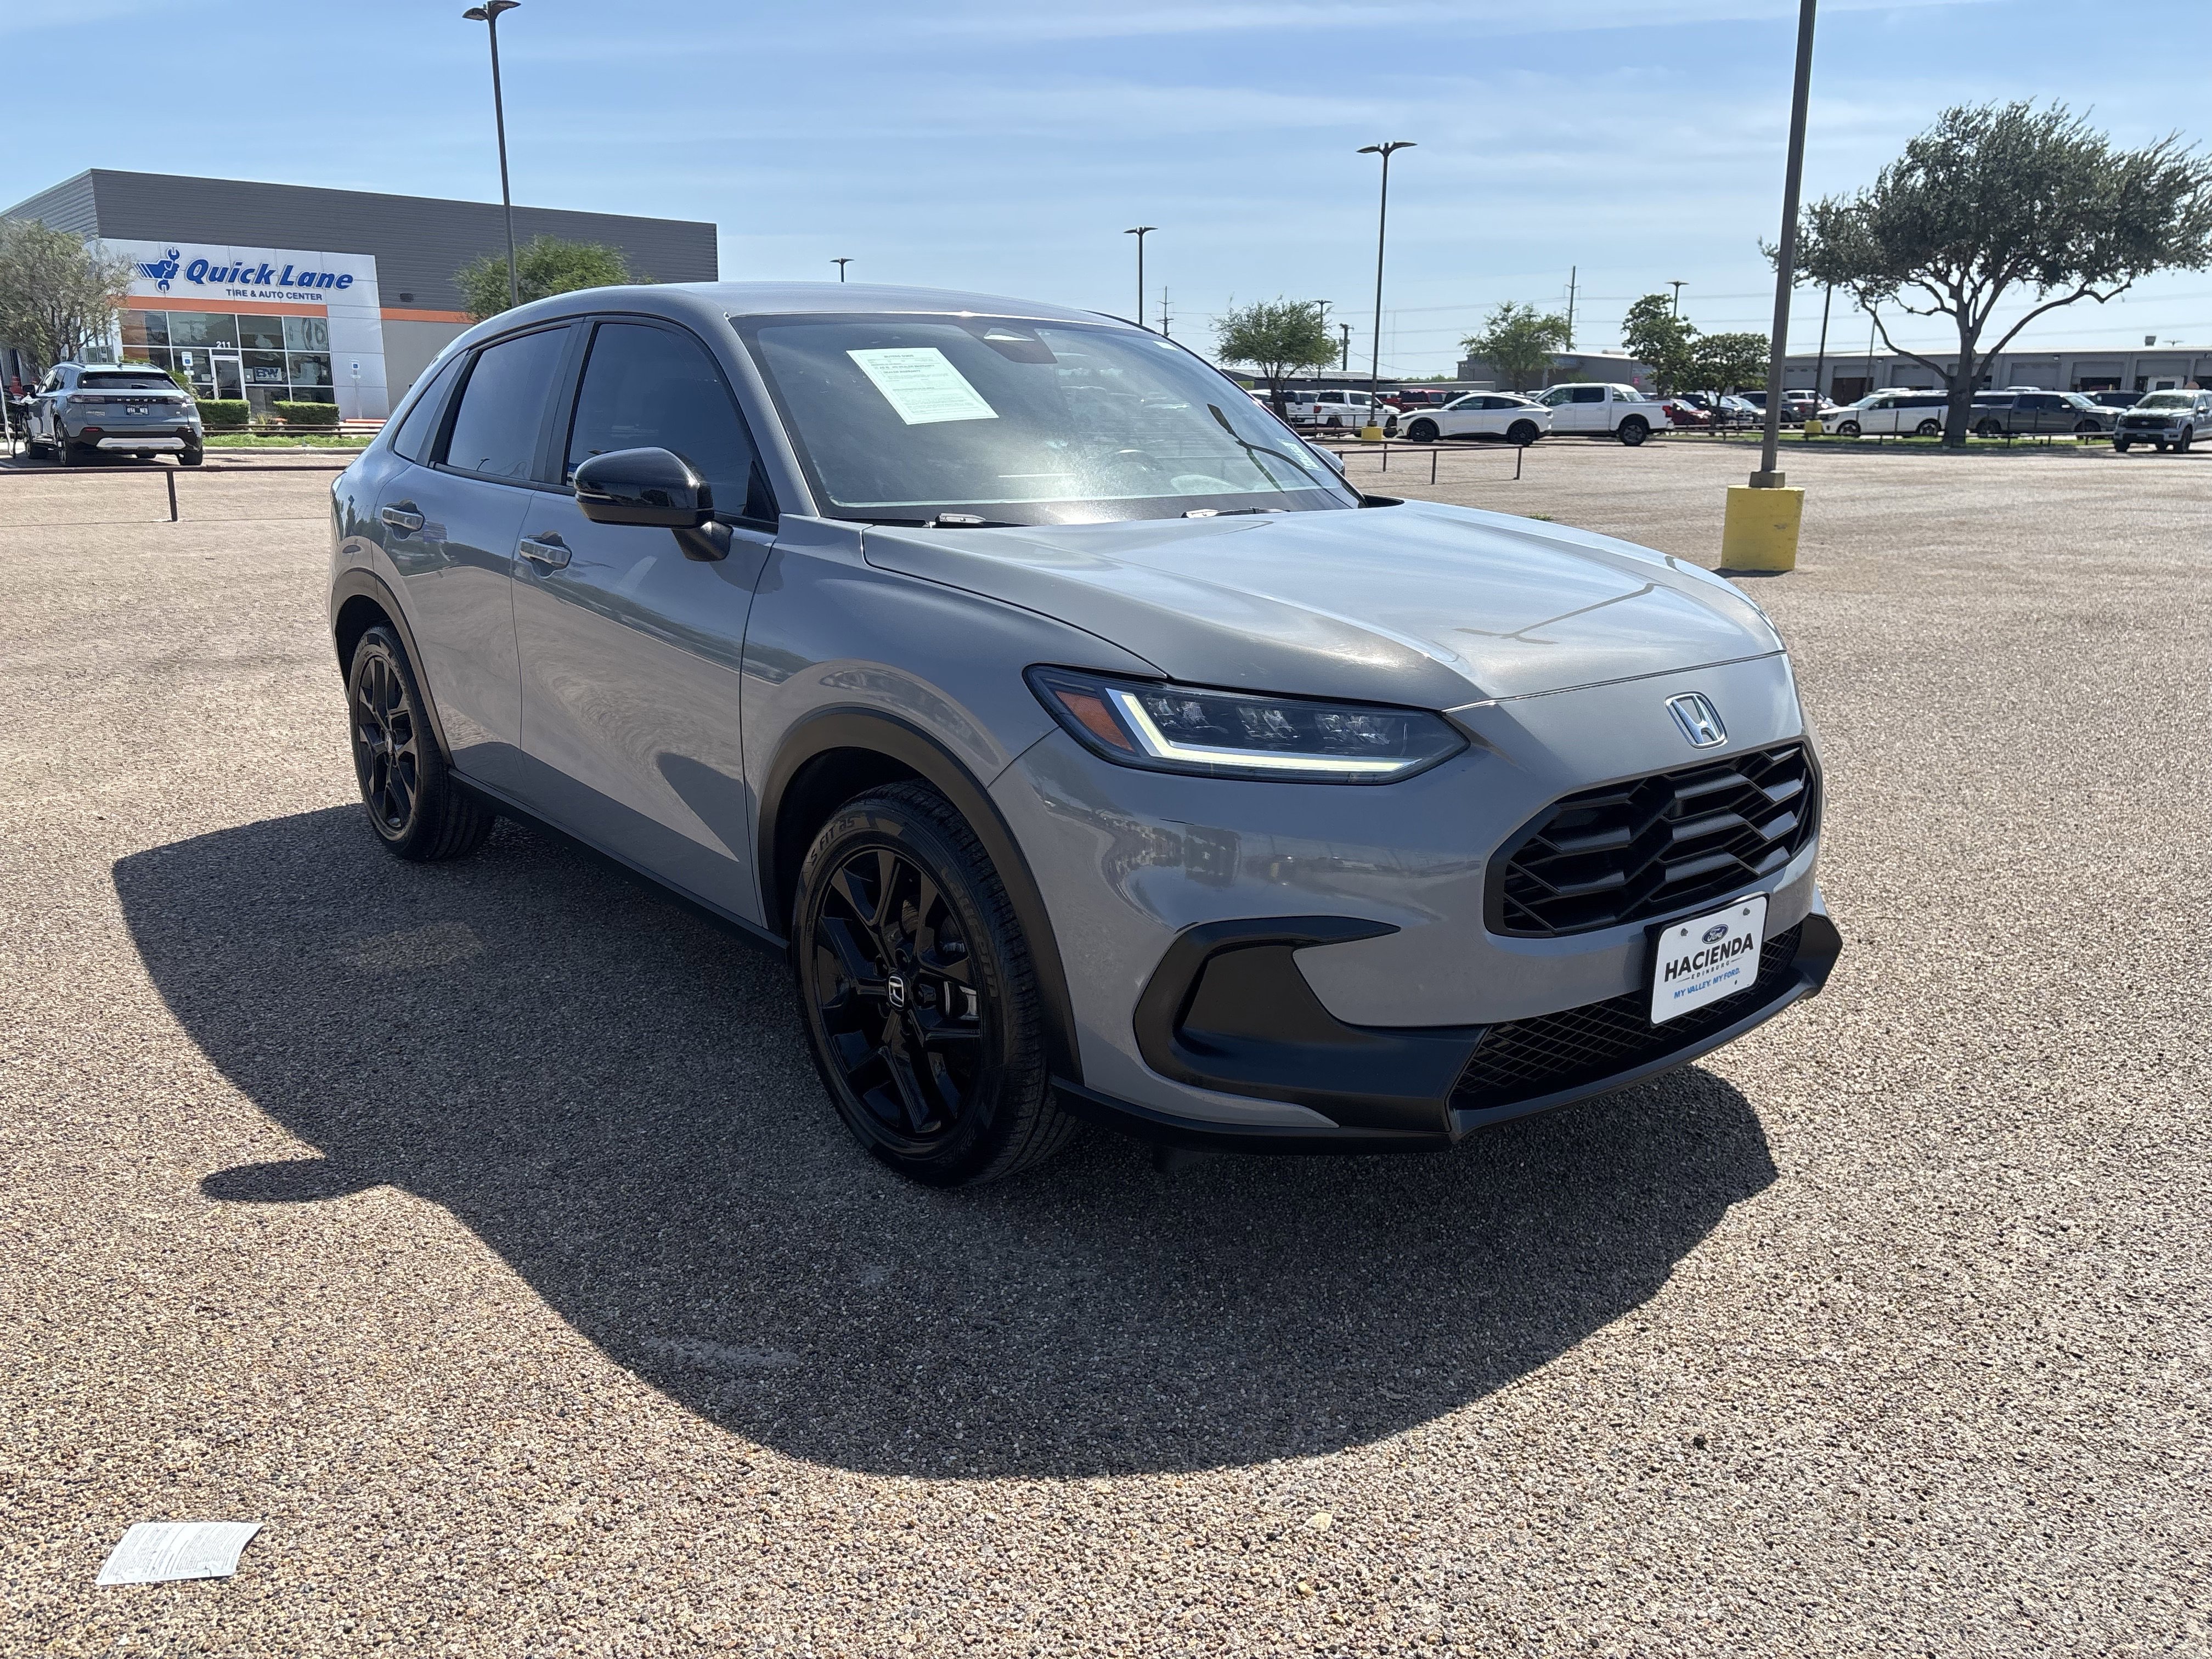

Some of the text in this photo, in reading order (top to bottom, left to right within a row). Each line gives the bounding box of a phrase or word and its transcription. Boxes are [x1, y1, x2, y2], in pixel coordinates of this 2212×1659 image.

[185, 258, 354, 290] Quick Lane
[225, 289, 248, 297] TIRE
[258, 290, 284, 299] AUTO
[286, 292, 323, 301] CENTER
[820, 826, 835, 851] FIT
[1664, 933, 1754, 983] HACIENDA
[1691, 961, 1730, 980] EDINBURG
[1673, 988, 1686, 999] MY
[1712, 974, 1723, 985] MY
